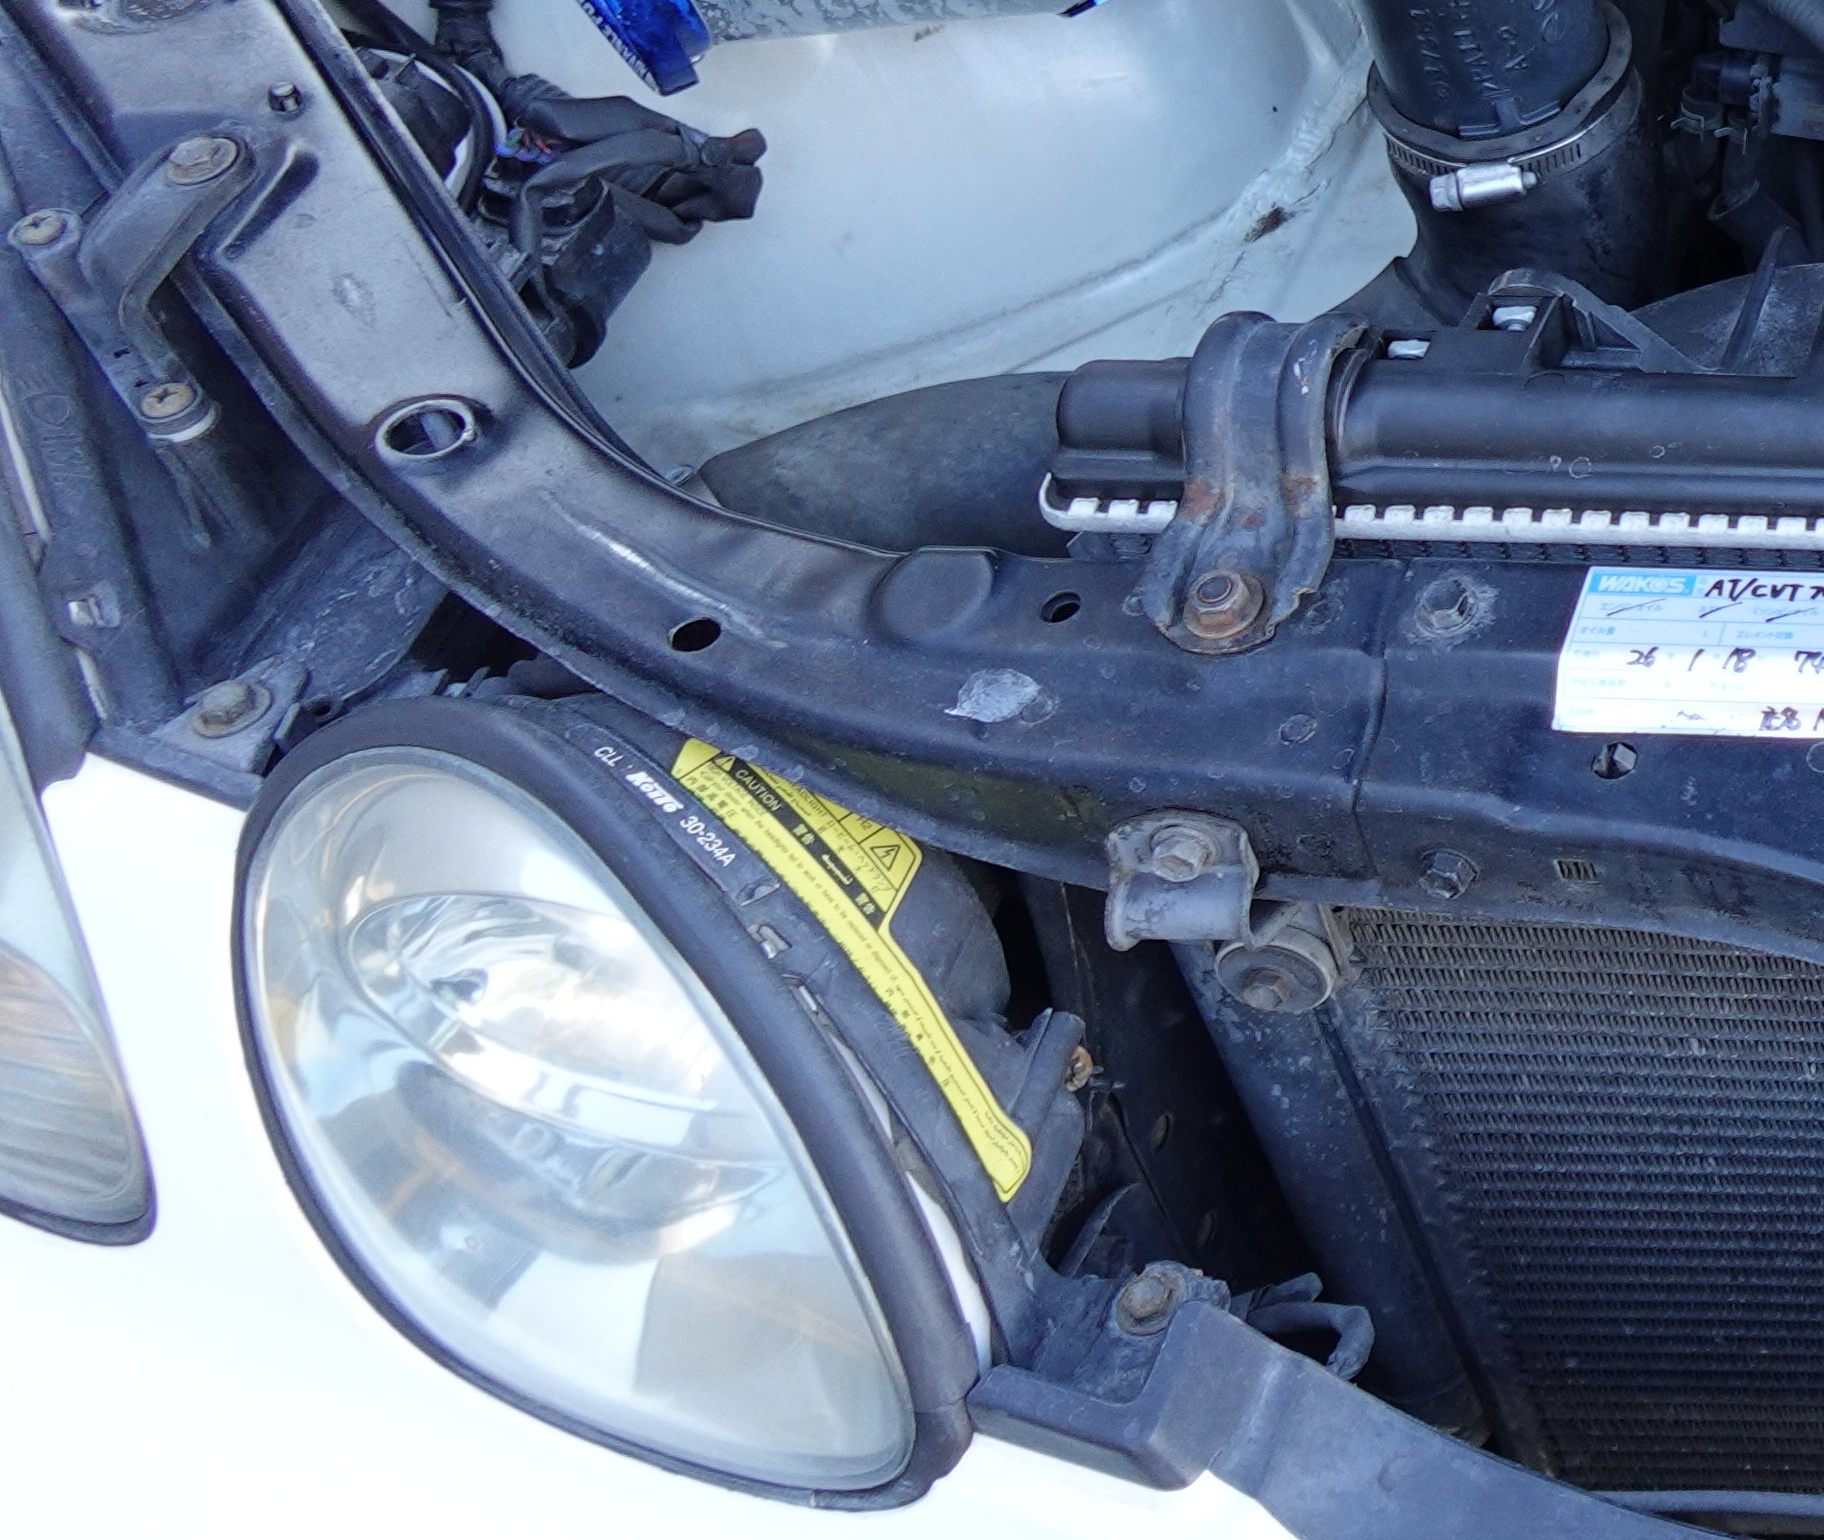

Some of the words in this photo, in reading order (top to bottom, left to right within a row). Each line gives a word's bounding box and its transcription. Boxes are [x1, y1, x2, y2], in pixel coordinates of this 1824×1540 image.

[1704, 577, 1804, 601] AT/CVT
[1626, 646, 1659, 667] 26
[594, 746, 624, 767] CLL
[679, 815, 736, 867] 30-234A
[734, 765, 782, 813] CAUTION
